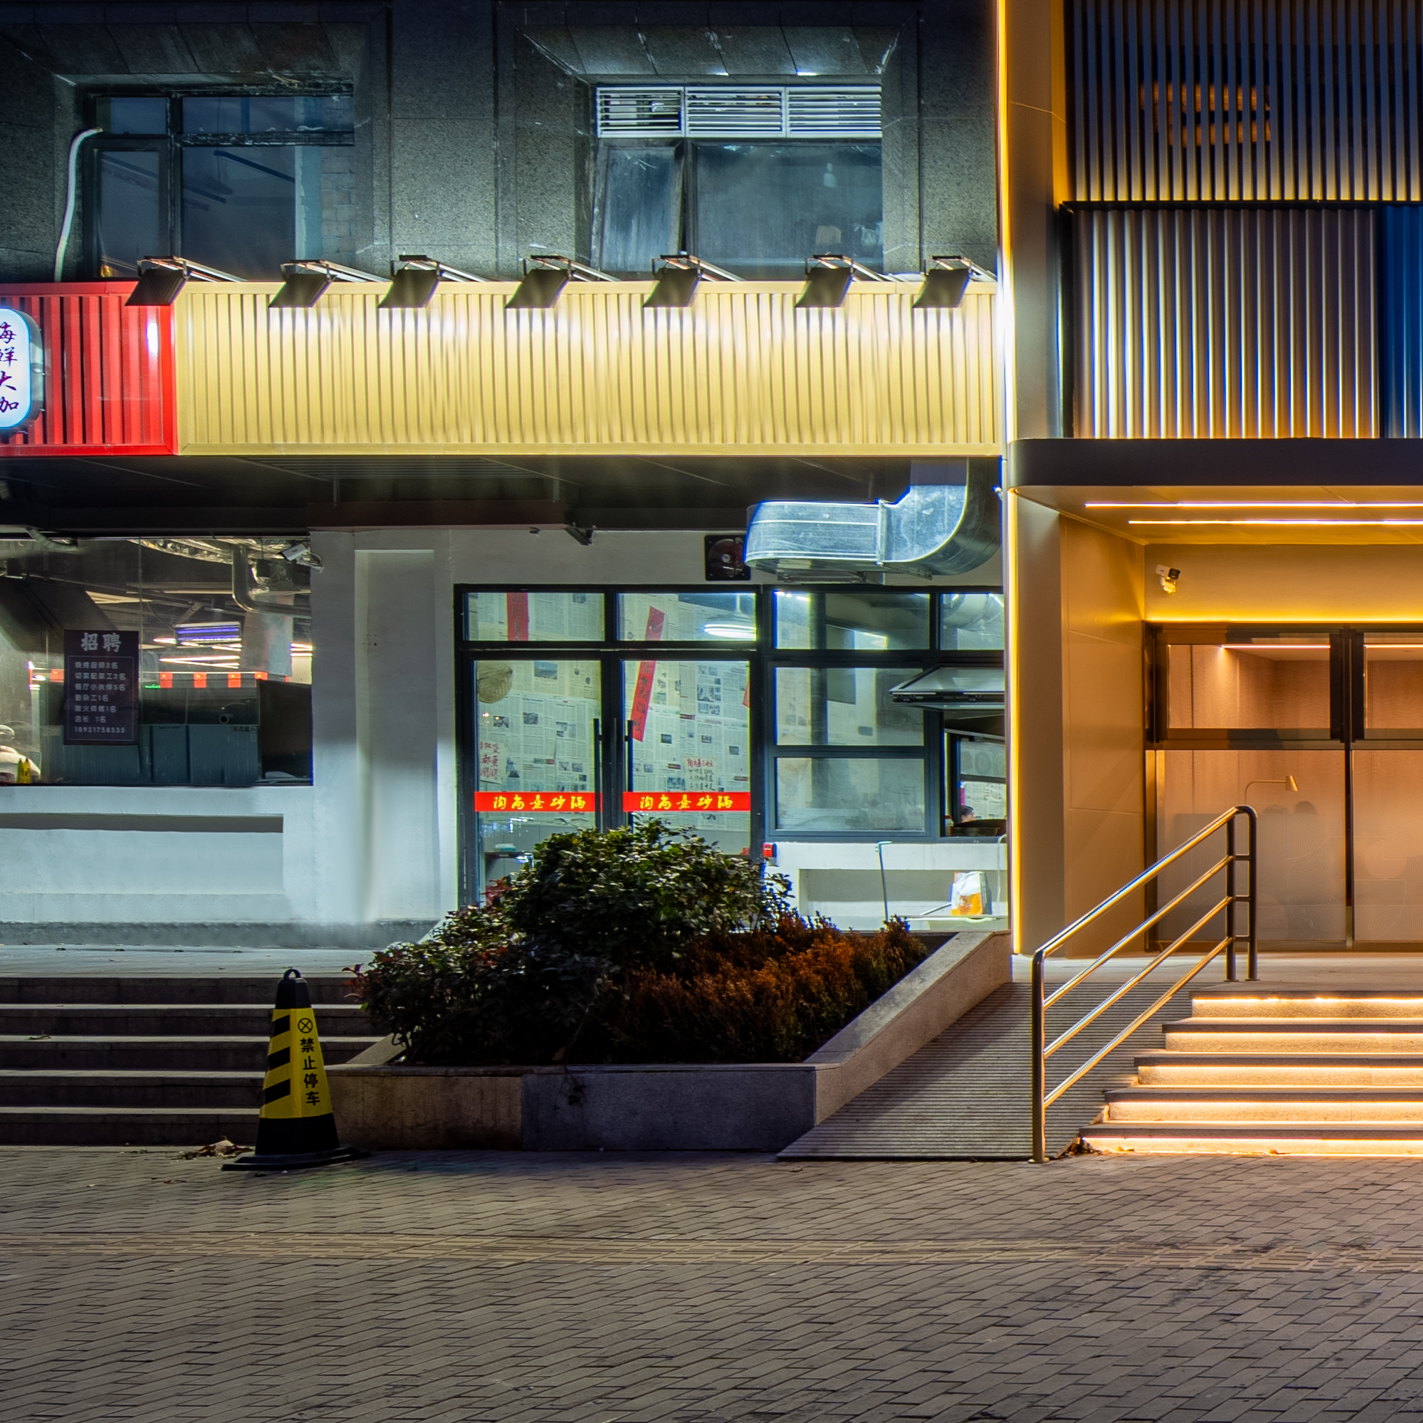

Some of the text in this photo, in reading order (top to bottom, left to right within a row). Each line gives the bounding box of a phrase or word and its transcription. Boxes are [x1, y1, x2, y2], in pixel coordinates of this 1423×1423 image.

[81, 632, 121, 652] 招聘
[300, 1037, 320, 1106] 禁止停车
